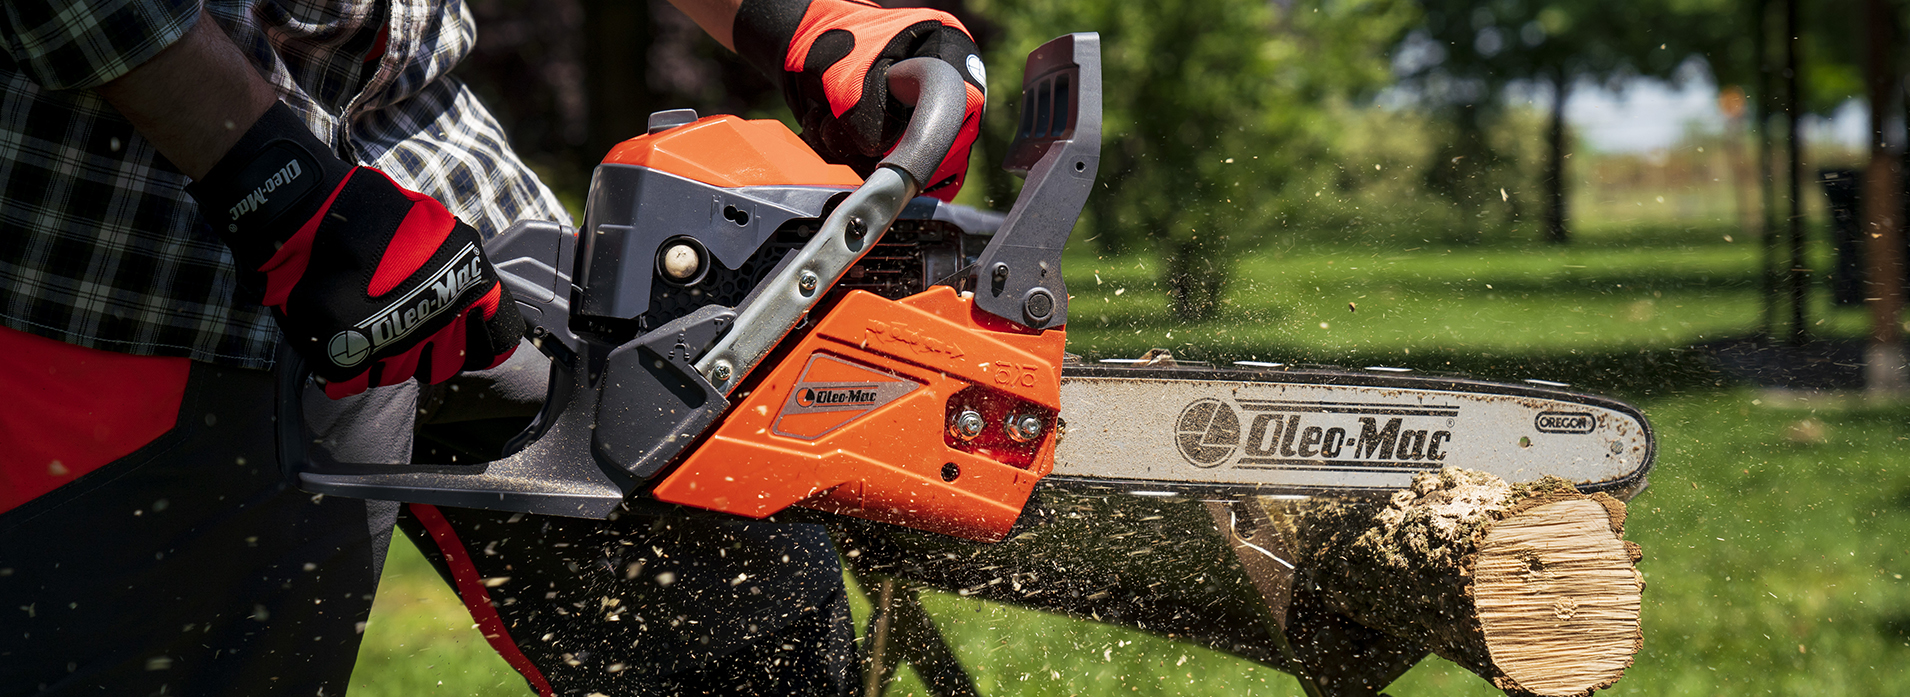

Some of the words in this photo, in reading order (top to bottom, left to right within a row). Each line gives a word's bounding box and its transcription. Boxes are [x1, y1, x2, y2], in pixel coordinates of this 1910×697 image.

[229, 159, 302, 220] Oleo-Mac
[371, 256, 482, 346] Oleo-Mac
[816, 390, 877, 403] Oleo-Mac
[1246, 414, 1451, 460] Oleo-Mac
[1540, 417, 1586, 428] OREGON
